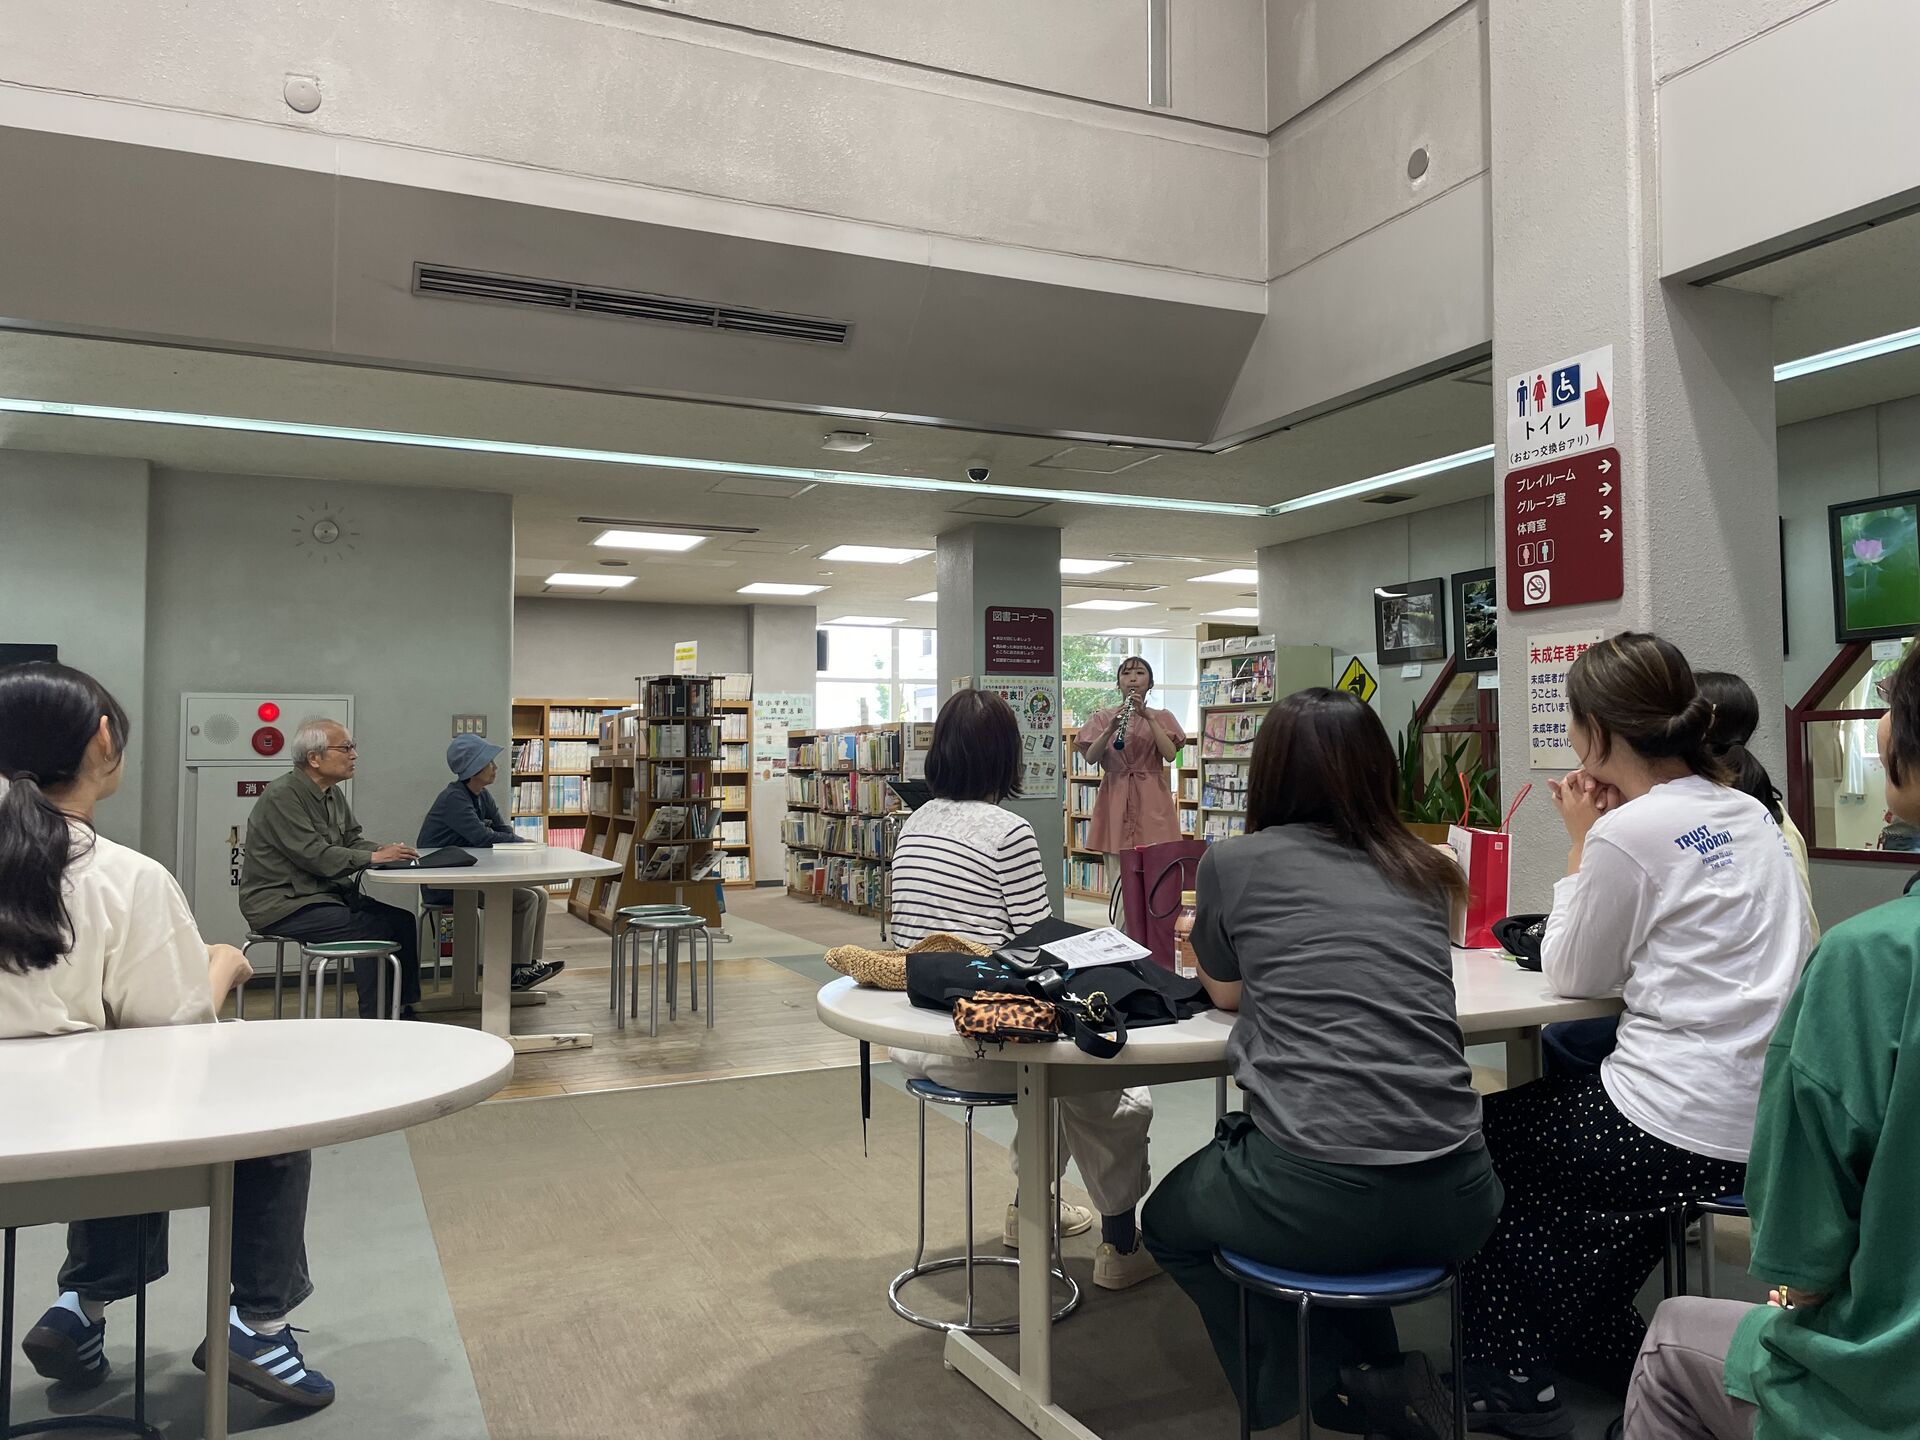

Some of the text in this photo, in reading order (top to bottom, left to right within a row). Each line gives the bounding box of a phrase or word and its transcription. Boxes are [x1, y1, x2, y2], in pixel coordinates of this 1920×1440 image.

[1526, 413, 1571, 440] トイレ
[1516, 468, 1577, 493] プレイルーム
[1516, 492, 1567, 514] グループ室
[1516, 518, 1547, 536] 体育室
[992, 610, 1048, 622] 図書コーナー
[1530, 642, 1598, 664] 未成年者禁
[1530, 672, 1569, 684] 未成年者が
[1530, 688, 1569, 700] うことは、
[245, 783, 267, 795] 消
[1674, 824, 1711, 850] TRUST
[1693, 830, 1733, 855] WORTHY
